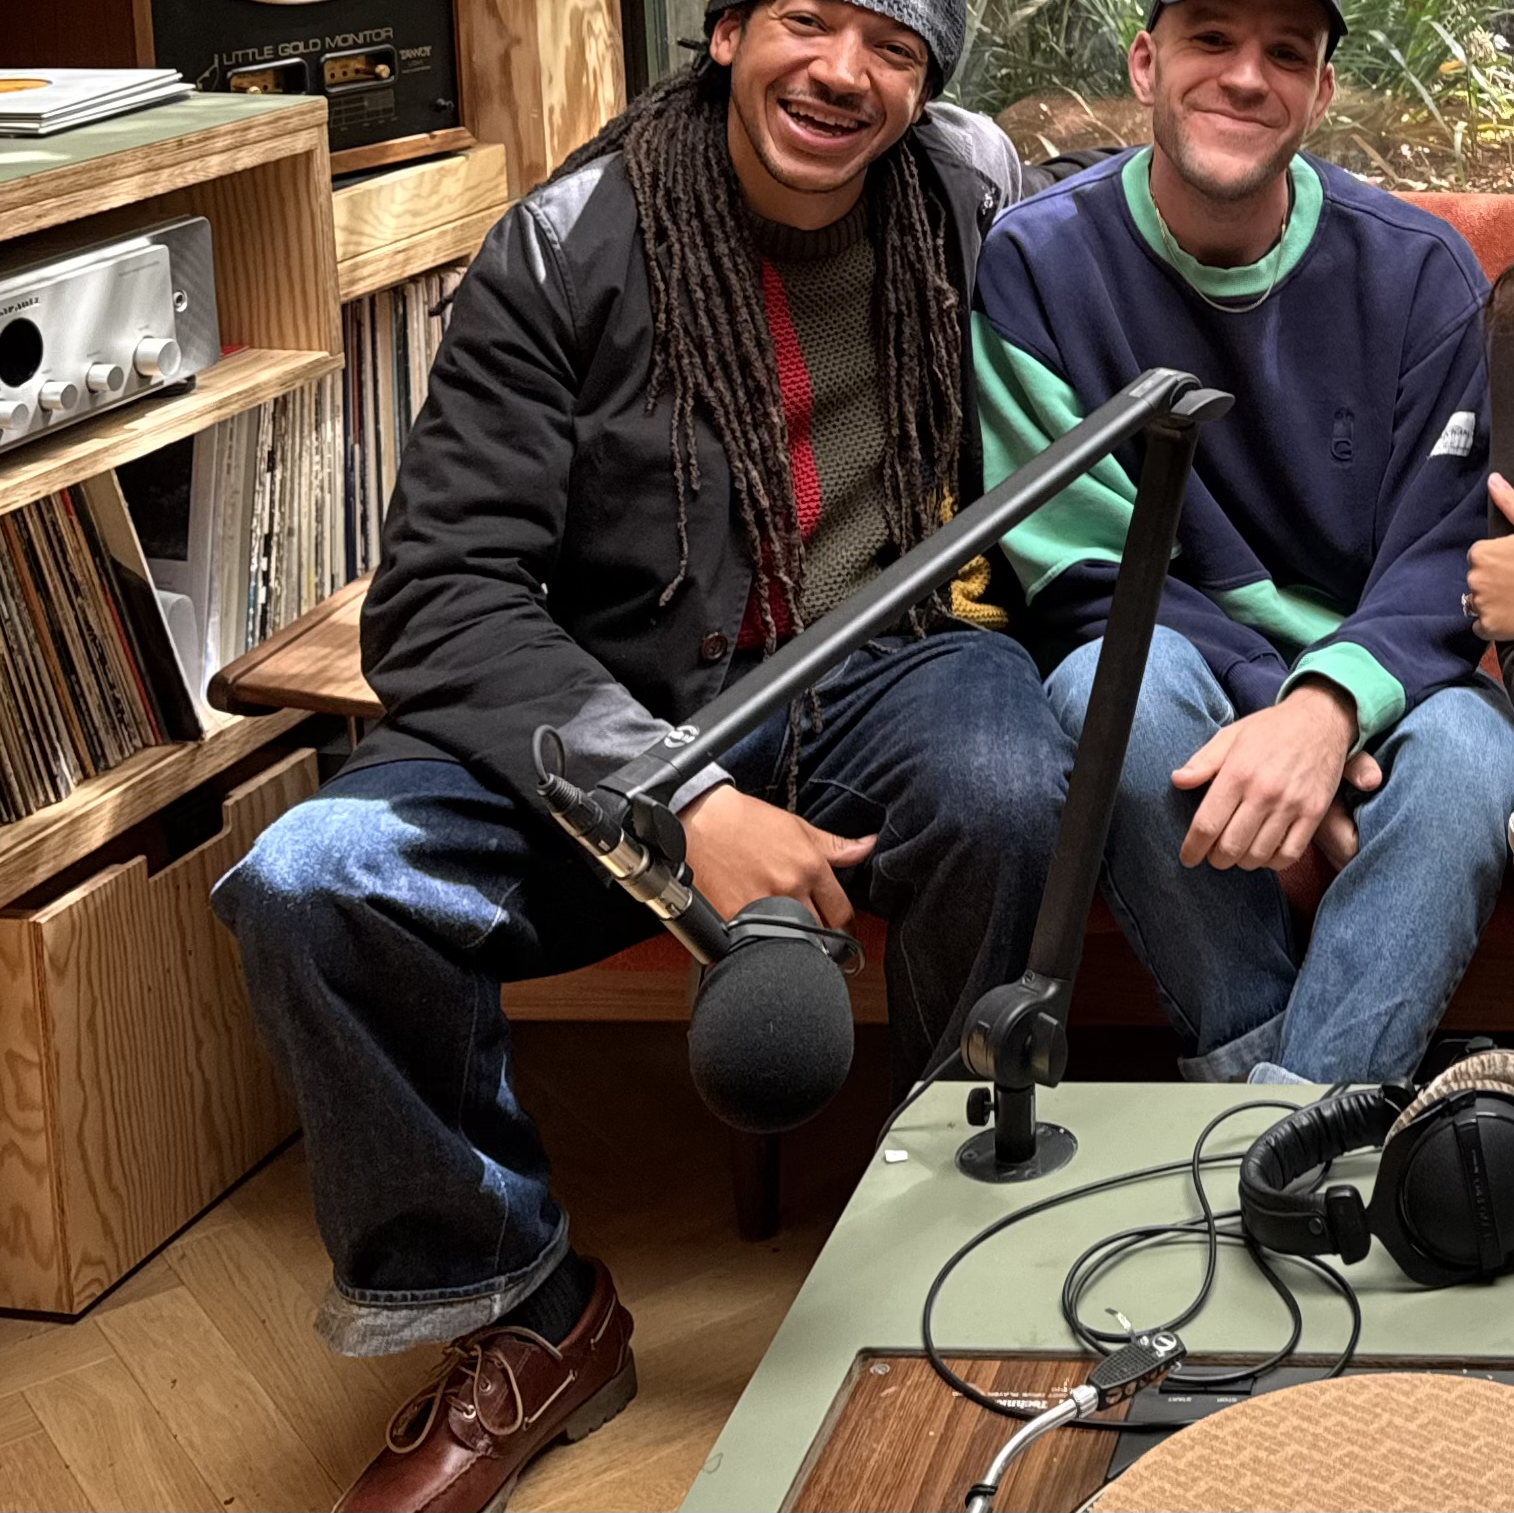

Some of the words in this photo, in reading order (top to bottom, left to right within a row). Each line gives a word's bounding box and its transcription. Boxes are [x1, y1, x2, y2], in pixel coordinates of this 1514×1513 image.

[223, 45, 275, 65] LITTLE
[278, 38, 321, 57] GOLD
[325, 27, 394, 49] MONITOR
